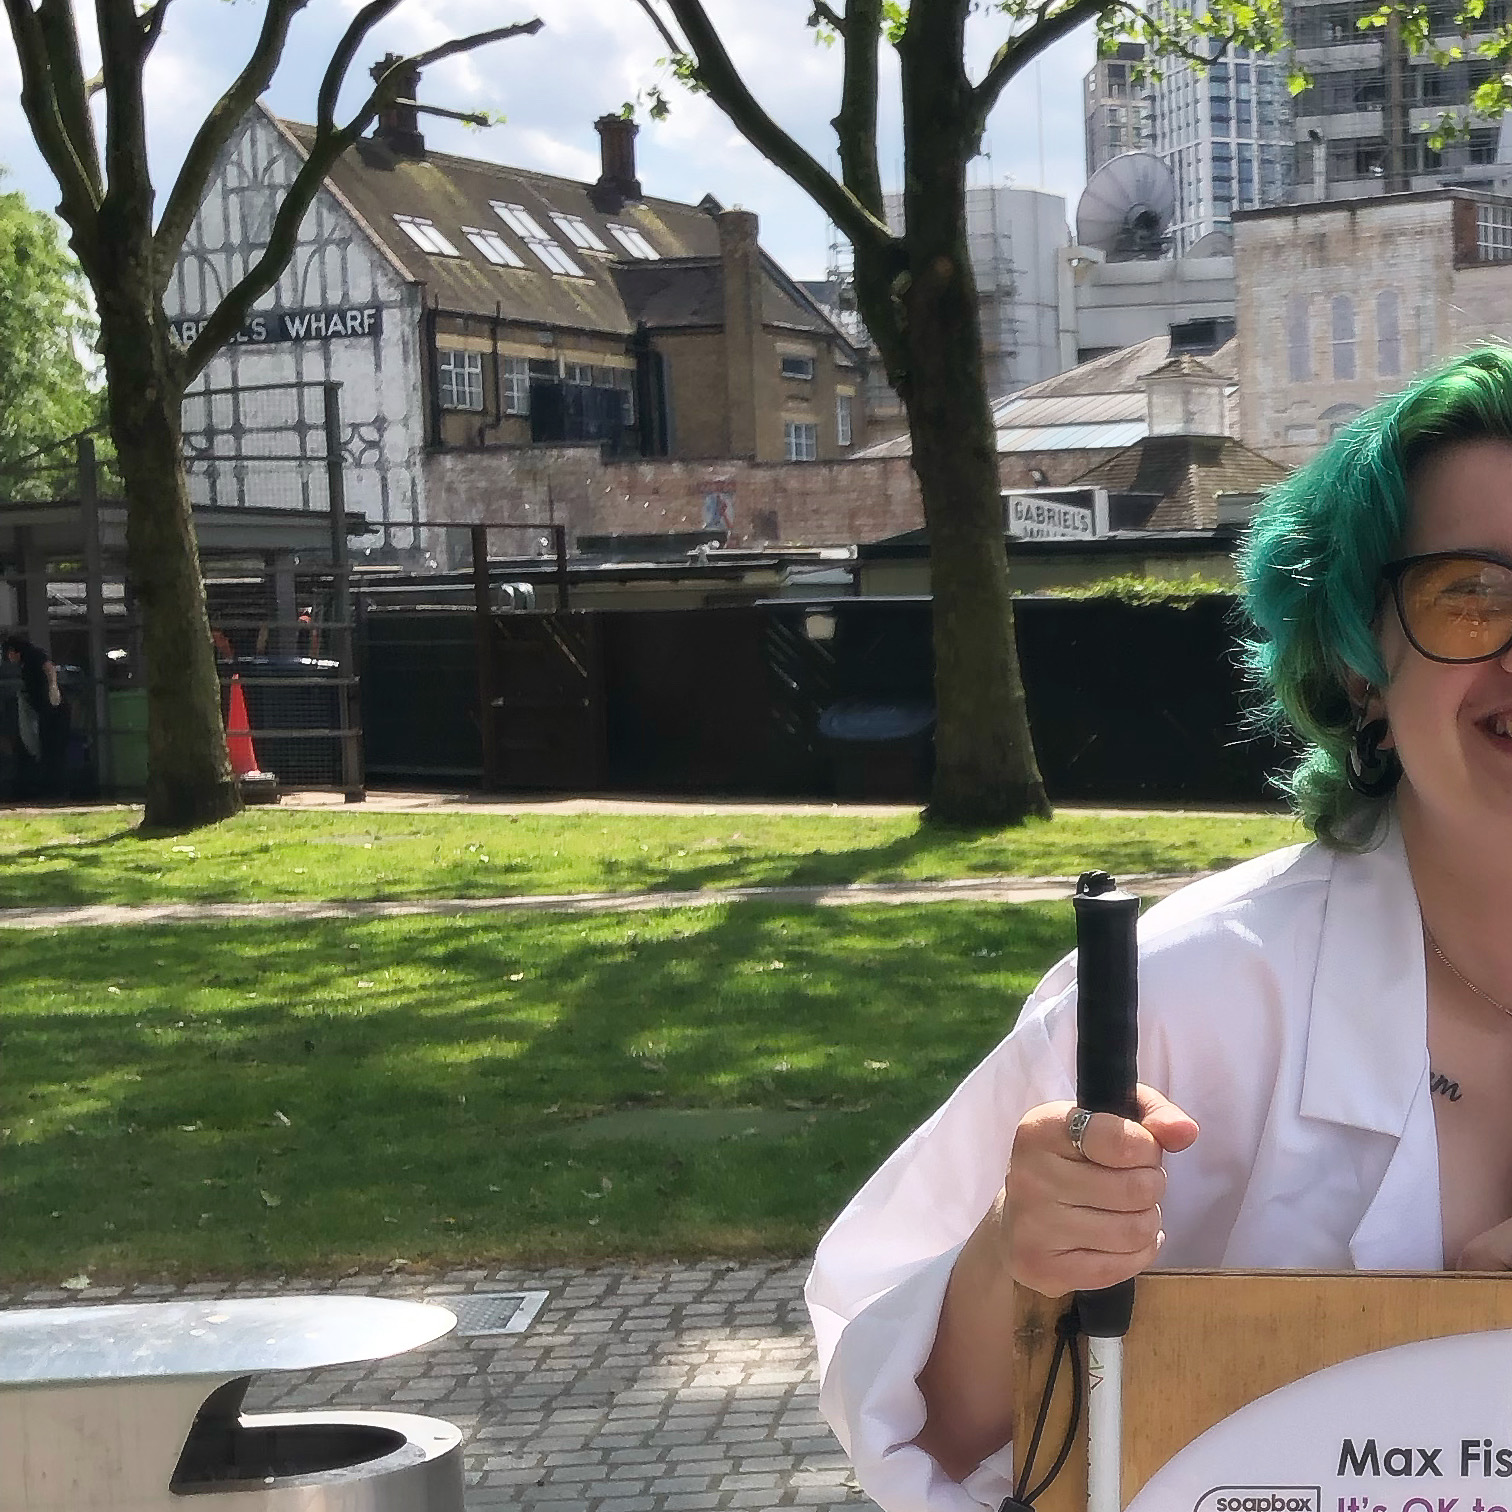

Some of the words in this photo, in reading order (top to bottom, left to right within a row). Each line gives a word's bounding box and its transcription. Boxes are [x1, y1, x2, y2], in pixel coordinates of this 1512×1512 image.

[284, 308, 377, 340] WHARF
[1013, 500, 1090, 533] GABRIEL'S
[1336, 1438, 1443, 1477] Max
